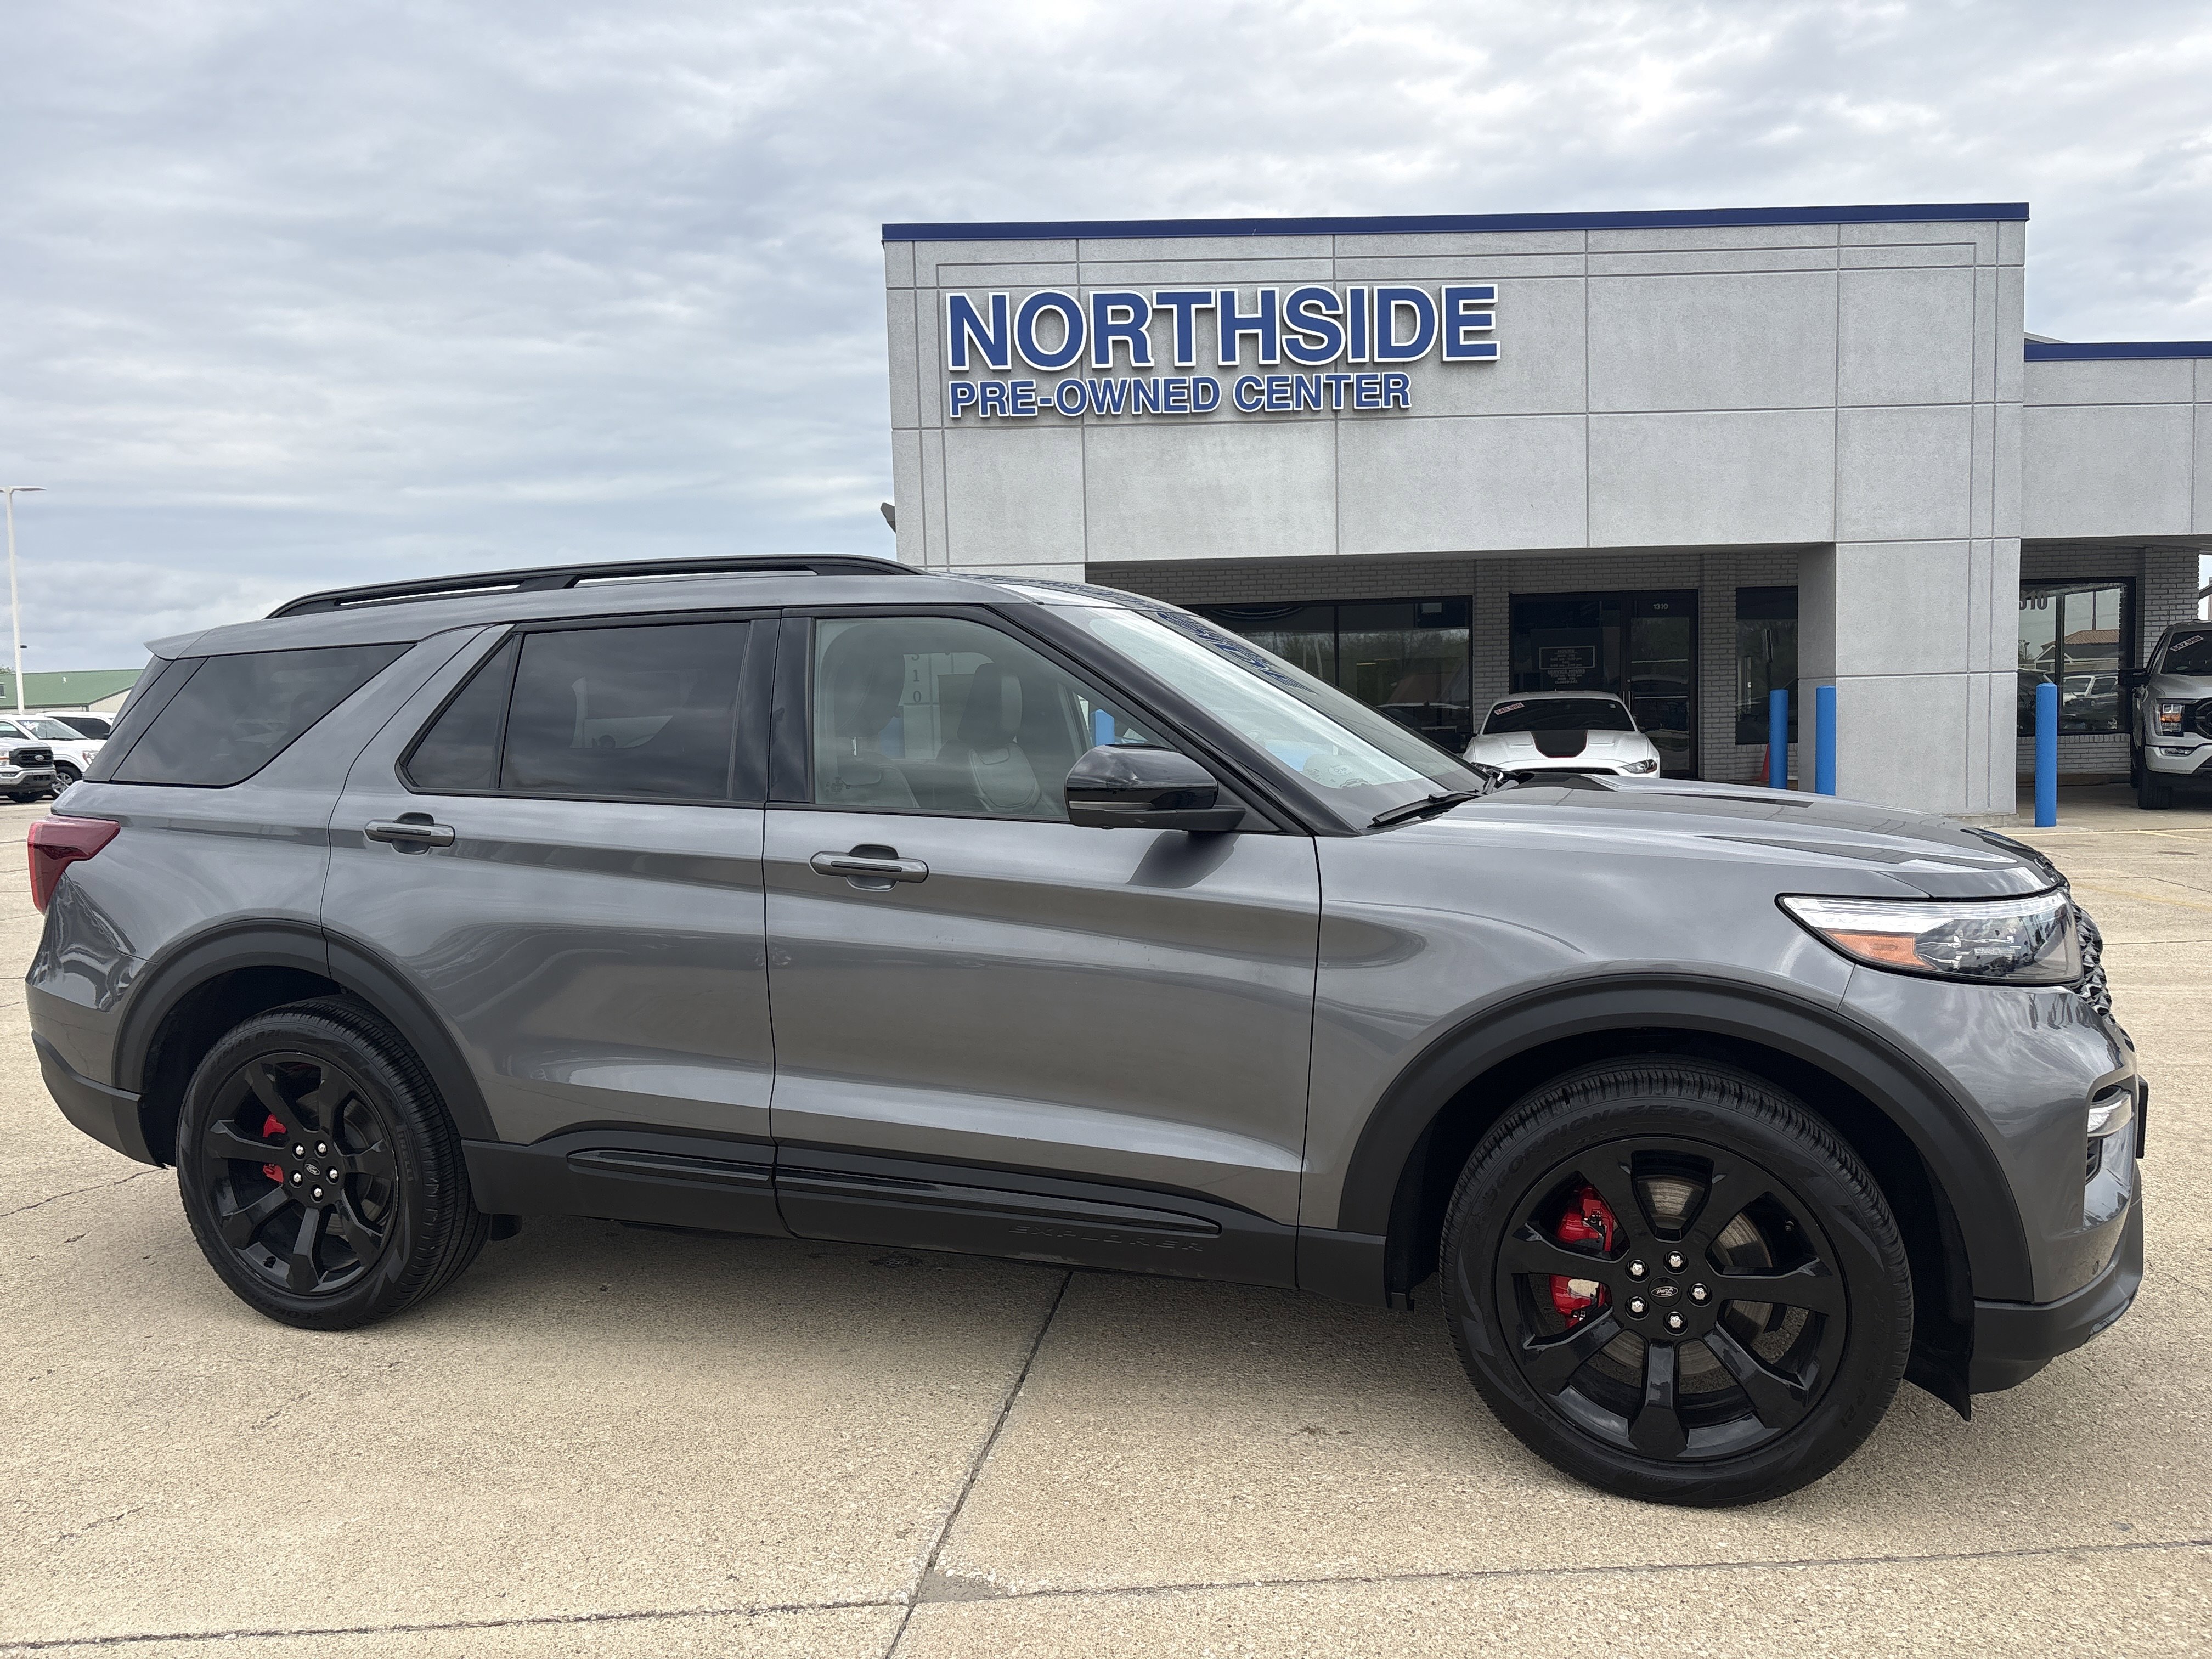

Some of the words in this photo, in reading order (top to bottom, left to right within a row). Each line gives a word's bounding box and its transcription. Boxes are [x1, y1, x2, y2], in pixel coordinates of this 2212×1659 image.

[946, 284, 1502, 371] NORTHSIDE
[949, 376, 1221, 419] PRE-OWNED
[1233, 373, 1412, 412] CENTER
[1008, 1226, 1203, 1252] EXPLORER
